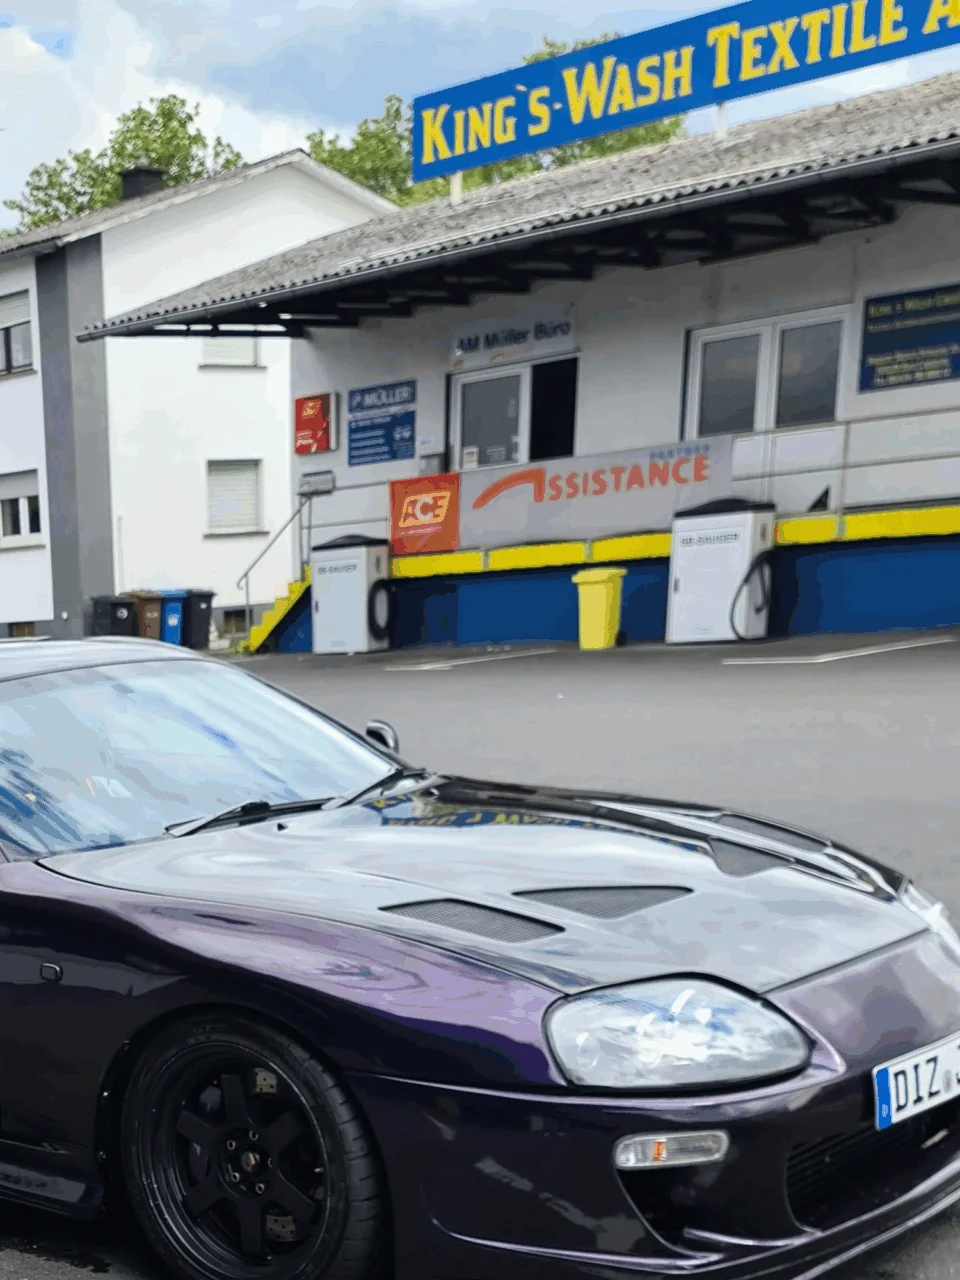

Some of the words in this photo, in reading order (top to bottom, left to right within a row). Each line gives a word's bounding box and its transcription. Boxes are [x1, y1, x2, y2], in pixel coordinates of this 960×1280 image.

[706, 0, 908, 89] TEXTILE
[534, 321, 572, 341] Büro
[894, 1055, 940, 1113] DIZ
